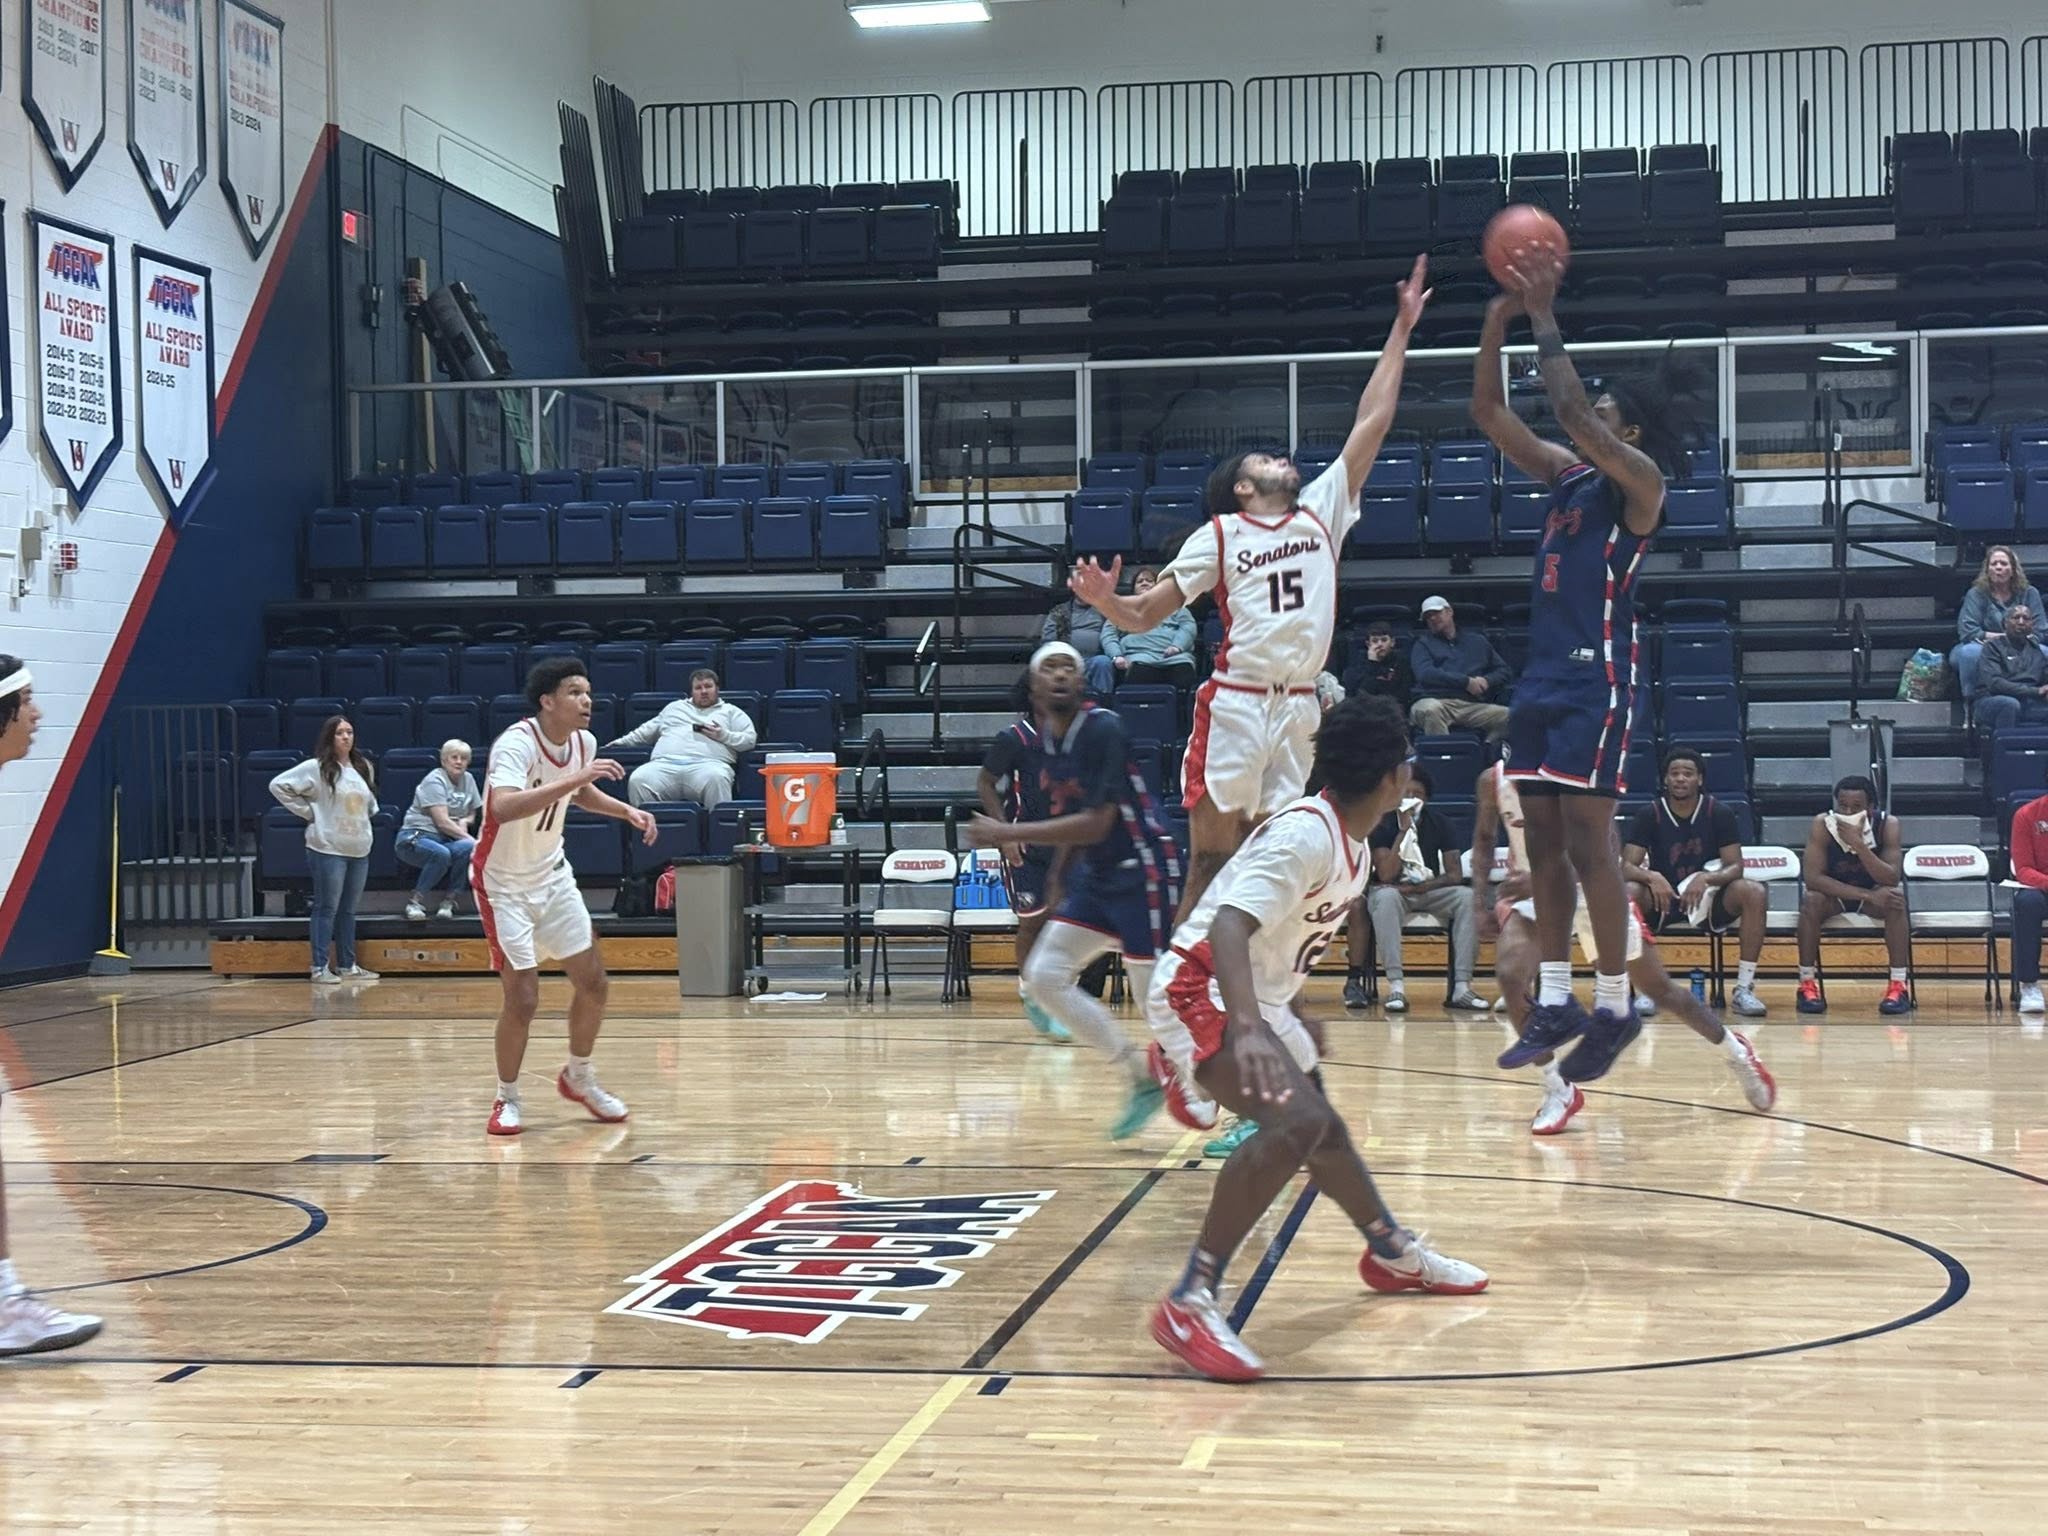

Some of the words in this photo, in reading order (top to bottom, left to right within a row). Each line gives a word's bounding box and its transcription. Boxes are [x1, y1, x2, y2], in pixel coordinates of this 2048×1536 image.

[52, 241, 102, 291] TCCAA
[44, 291, 65, 314] ALL
[67, 297, 106, 325] SPORTS
[153, 274, 197, 321] TCCAA
[59, 317, 94, 343] AWARD
[145, 321, 165, 343] ALL
[166, 327, 203, 352] SPORTS
[46, 343, 75, 363] 2014-15
[159, 344, 190, 369] AWARD
[146, 369, 176, 389] 2024-25
[46, 400, 77, 419] 2021-22
[79, 406, 107, 425] 2022-23
[1236, 536, 1321, 574] Senators
[1541, 553, 1561, 593] 5
[1267, 569, 1305, 614] 15
[783, 778, 806, 802] G
[535, 801, 559, 832] 11
[893, 859, 946, 871] SENATORS
[1916, 855, 1976, 867] SENATORS
